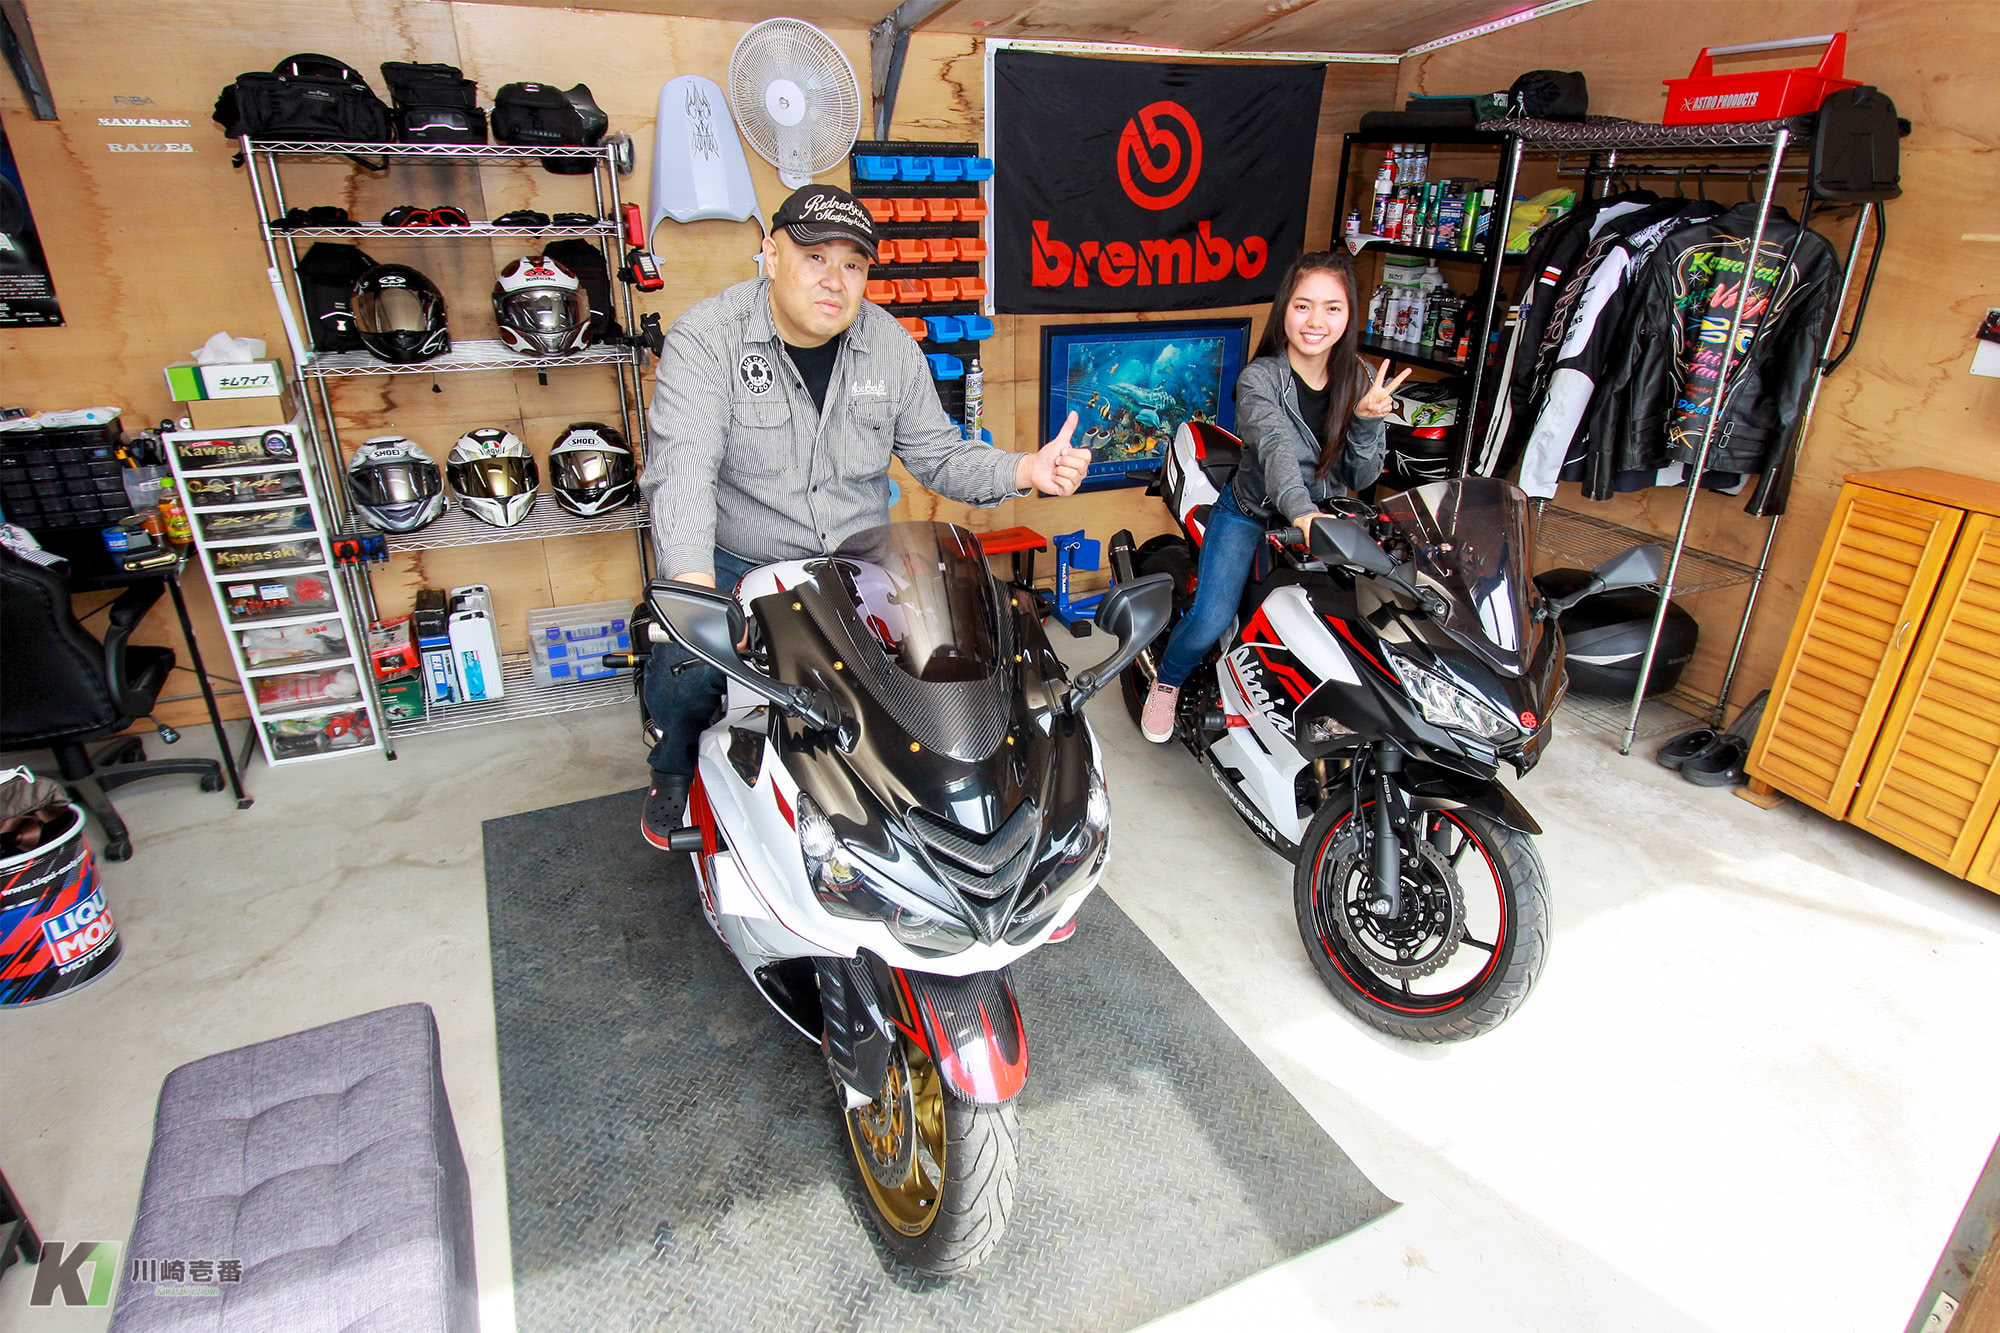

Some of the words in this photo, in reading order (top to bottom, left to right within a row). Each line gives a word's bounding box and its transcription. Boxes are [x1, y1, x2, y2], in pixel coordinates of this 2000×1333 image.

[1692, 95, 1717, 111] ASTRO
[1717, 91, 1759, 109] PRODUCTS
[98, 117, 191, 128] KAWASAKI
[1031, 219, 1268, 288] brembo
[374, 449, 400, 458] SHOEI
[572, 438, 595, 446] SHOEI
[216, 546, 297, 563] Kawasaki
[1228, 647, 1296, 742] Ninja
[1381, 774, 1392, 803] ABS
[1210, 763, 1277, 843] Kawasaki
[48, 884, 108, 940] LIQU
